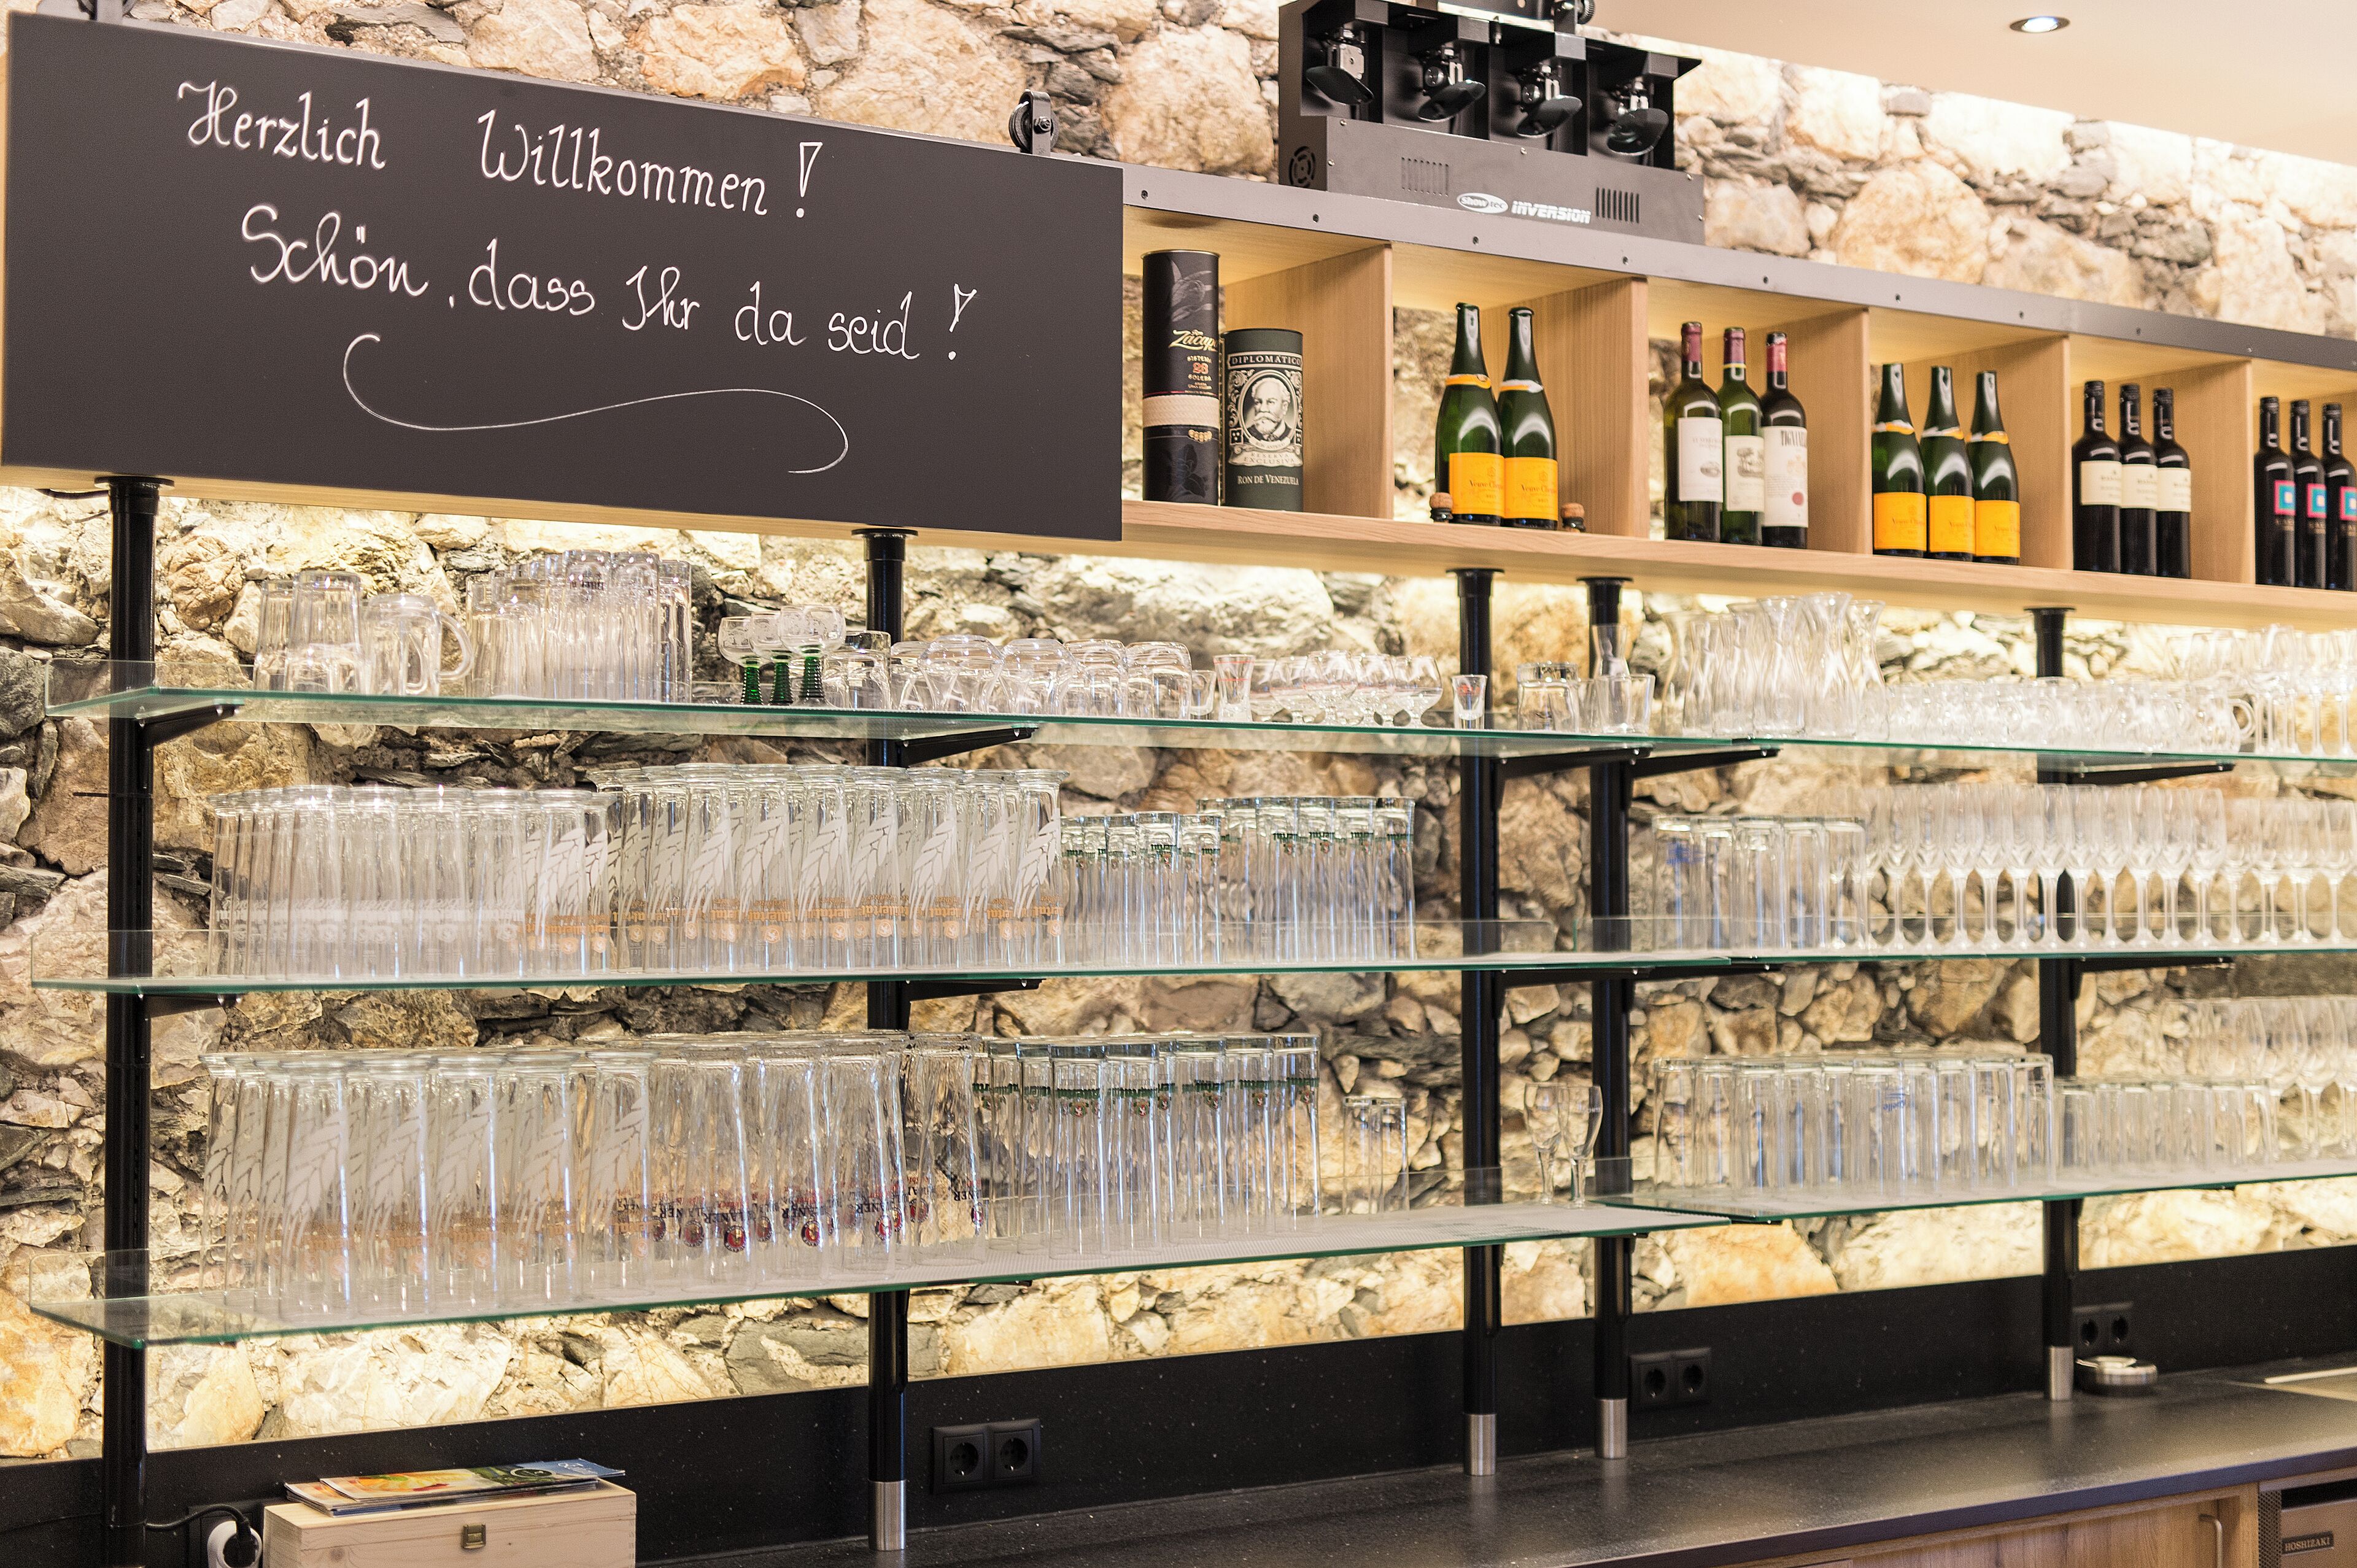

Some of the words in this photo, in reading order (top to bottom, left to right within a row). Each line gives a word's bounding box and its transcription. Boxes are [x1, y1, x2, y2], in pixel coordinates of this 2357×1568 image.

[177, 80, 385, 169] Herzlich
[478, 109, 768, 215] Willkommen
[241, 204, 428, 296] Schön
[621, 265, 700, 331] Ihr
[735, 280, 807, 346] da
[827, 291, 920, 360] seid
[1231, 355, 1301, 365] DIPLOMÁTICO
[1237, 476, 1253, 485] RON
[1253, 475, 1264, 484] DE
[2285, 1537, 2331, 1551] HOSHIZAKI
